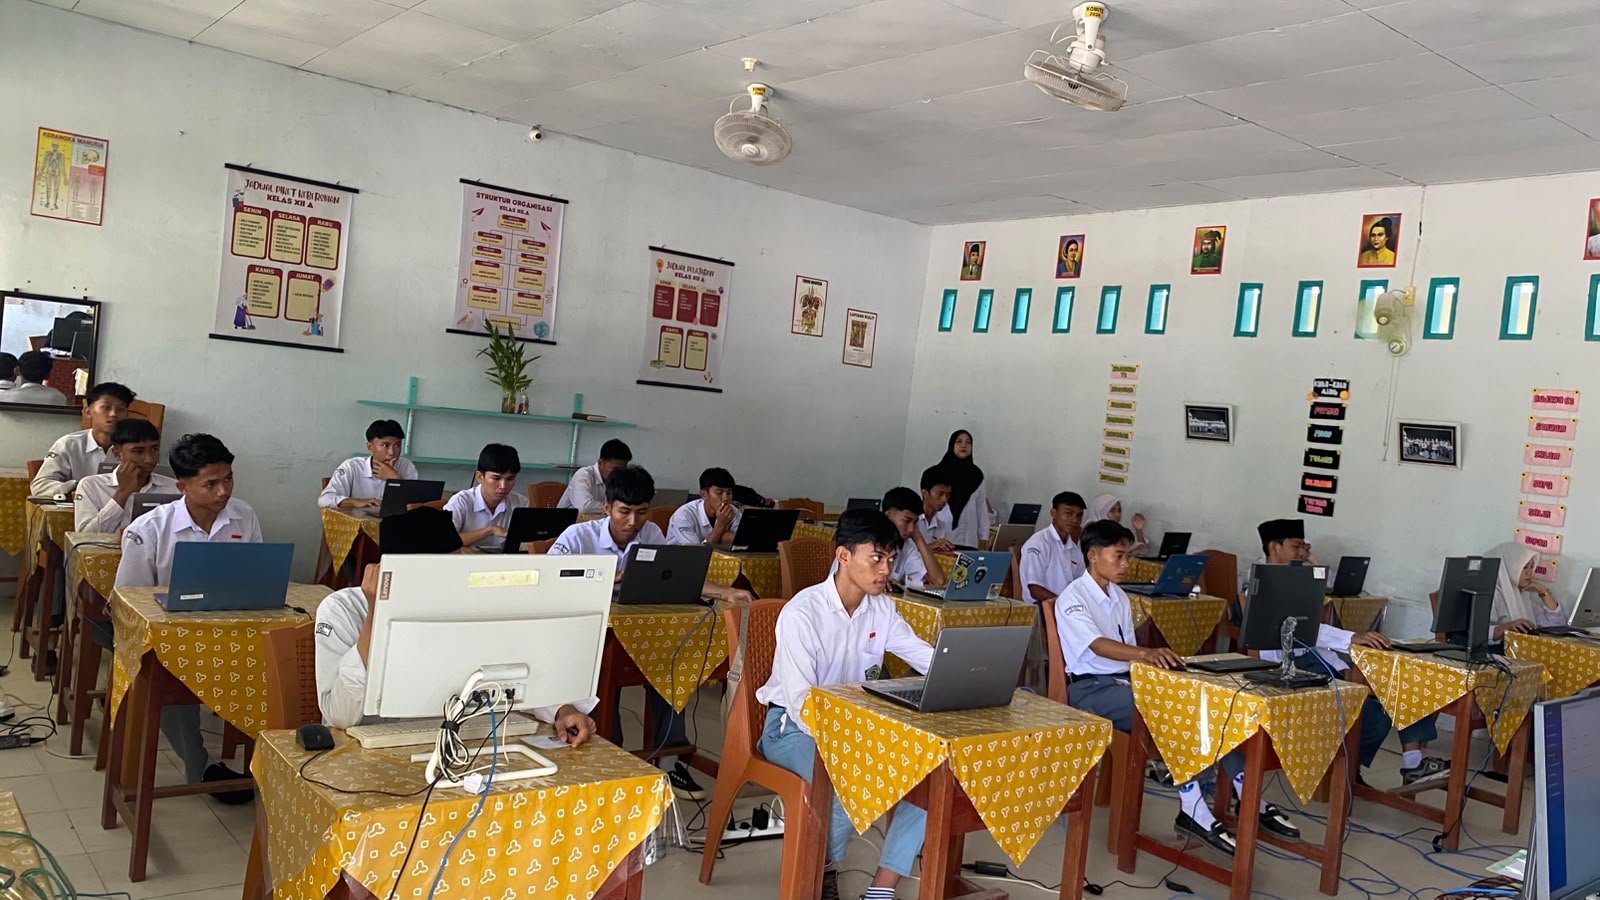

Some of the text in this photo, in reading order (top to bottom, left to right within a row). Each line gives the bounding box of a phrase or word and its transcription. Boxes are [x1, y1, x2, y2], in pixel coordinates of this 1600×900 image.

[77, 138, 104, 148] MANUSIA
[245, 179, 340, 204] JADWAL PIKET KEBERSIHAN
[267, 194, 293, 205] KELAS
[294, 198, 306, 207] XII
[476, 192, 553, 213] STRUKTUR ORGANISASI
[243, 207, 262, 215] SENIN
[500, 205, 516, 213] KELAS
[278, 213, 301, 221] SELASA
[255, 266, 275, 275] KAMIS
[296, 273, 315, 281] JUMAT
[675, 272, 692, 280] KELAS
[380, 573, 390, 599] Lenovo
